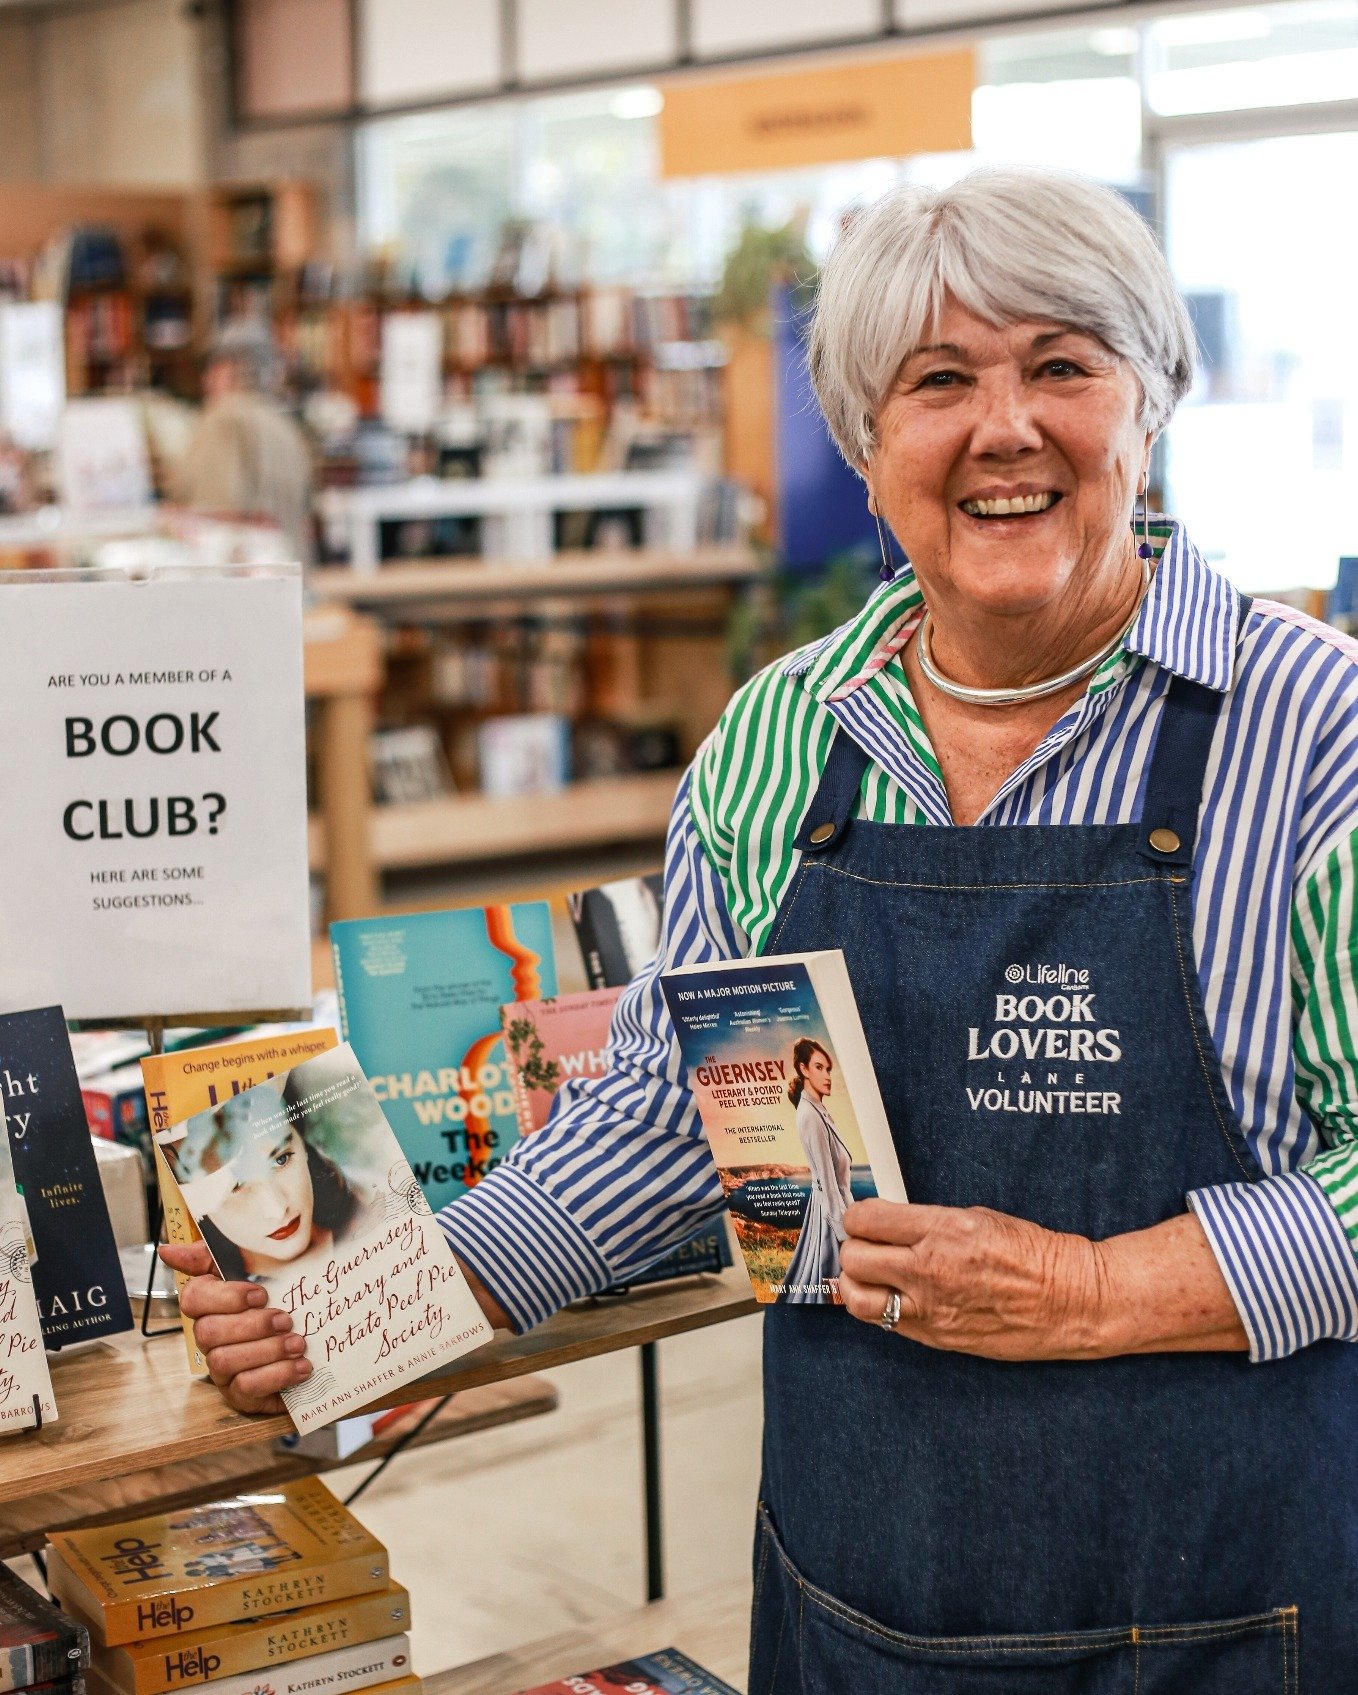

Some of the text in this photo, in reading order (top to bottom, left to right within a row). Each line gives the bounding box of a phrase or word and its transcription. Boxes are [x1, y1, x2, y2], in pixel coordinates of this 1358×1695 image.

[48, 669, 232, 688] ARE YOU A MEMBER OF A
[65, 711, 221, 758] BOOK
[63, 792, 227, 841] CLUB?
[91, 866, 205, 884] HERE ARE SOME
[1026, 963, 1090, 984] Lifeline
[677, 981, 797, 1001] NOW A MAJOR MOTION PICTURE
[994, 993, 1096, 1022] BOOK
[183, 1041, 326, 1075] Change begins with a whisper
[967, 1027, 1122, 1062] LOVERS
[696, 1059, 786, 1087] GUERNSEY
[705, 1056, 717, 1064] THE
[286, 1103, 296, 1113] the
[296, 1098, 309, 1108] last
[309, 1091, 323, 1102] time
[324, 1085, 336, 1096] you
[336, 1076, 351, 1089] read
[711, 1085, 783, 1099] LITERARY & POTATO
[719, 1095, 781, 1108] PEEL PIE SOCIETY
[965, 1087, 1122, 1115] VOLUNTEER
[283, 1113, 300, 1125] made
[300, 1107, 313, 1118] you
[312, 1099, 324, 1113] feel
[324, 1092, 342, 1105] really
[441, 1128, 501, 1154] The
[724, 1124, 785, 1135] THE INTERNATIONAL
[738, 1134, 777, 1144] BESTSELLER
[283, 1217, 422, 1314] The Guernsey
[302, 1230, 430, 1339] Literary and
[769, 1284, 787, 1294] MARY
[788, 1284, 802, 1294] ANN
[803, 1284, 831, 1294] SHAFFER
[72, 1312, 113, 1329] AUTHOR
[325, 1264, 457, 1363] Potato Peel Pie
[7, 1332, 38, 1358] Pie
[374, 1303, 452, 1364] Society
[301, 1322, 486, 1423] MARY ANN SHAFFER & ANNIE BARROWS
[100, 1538, 174, 1585] Help
[242, 1575, 325, 1601] KATHRYN
[243, 1586, 325, 1611] STOCKETT
[137, 1597, 194, 1632] Help
[156, 1600, 170, 1611] the
[267, 1618, 348, 1646] KATHRYN
[268, 1629, 348, 1657] STOCKETT
[165, 1646, 221, 1682] Help
[183, 1650, 198, 1660] the
[287, 1662, 385, 1694] KATHRYN STOCKETT
